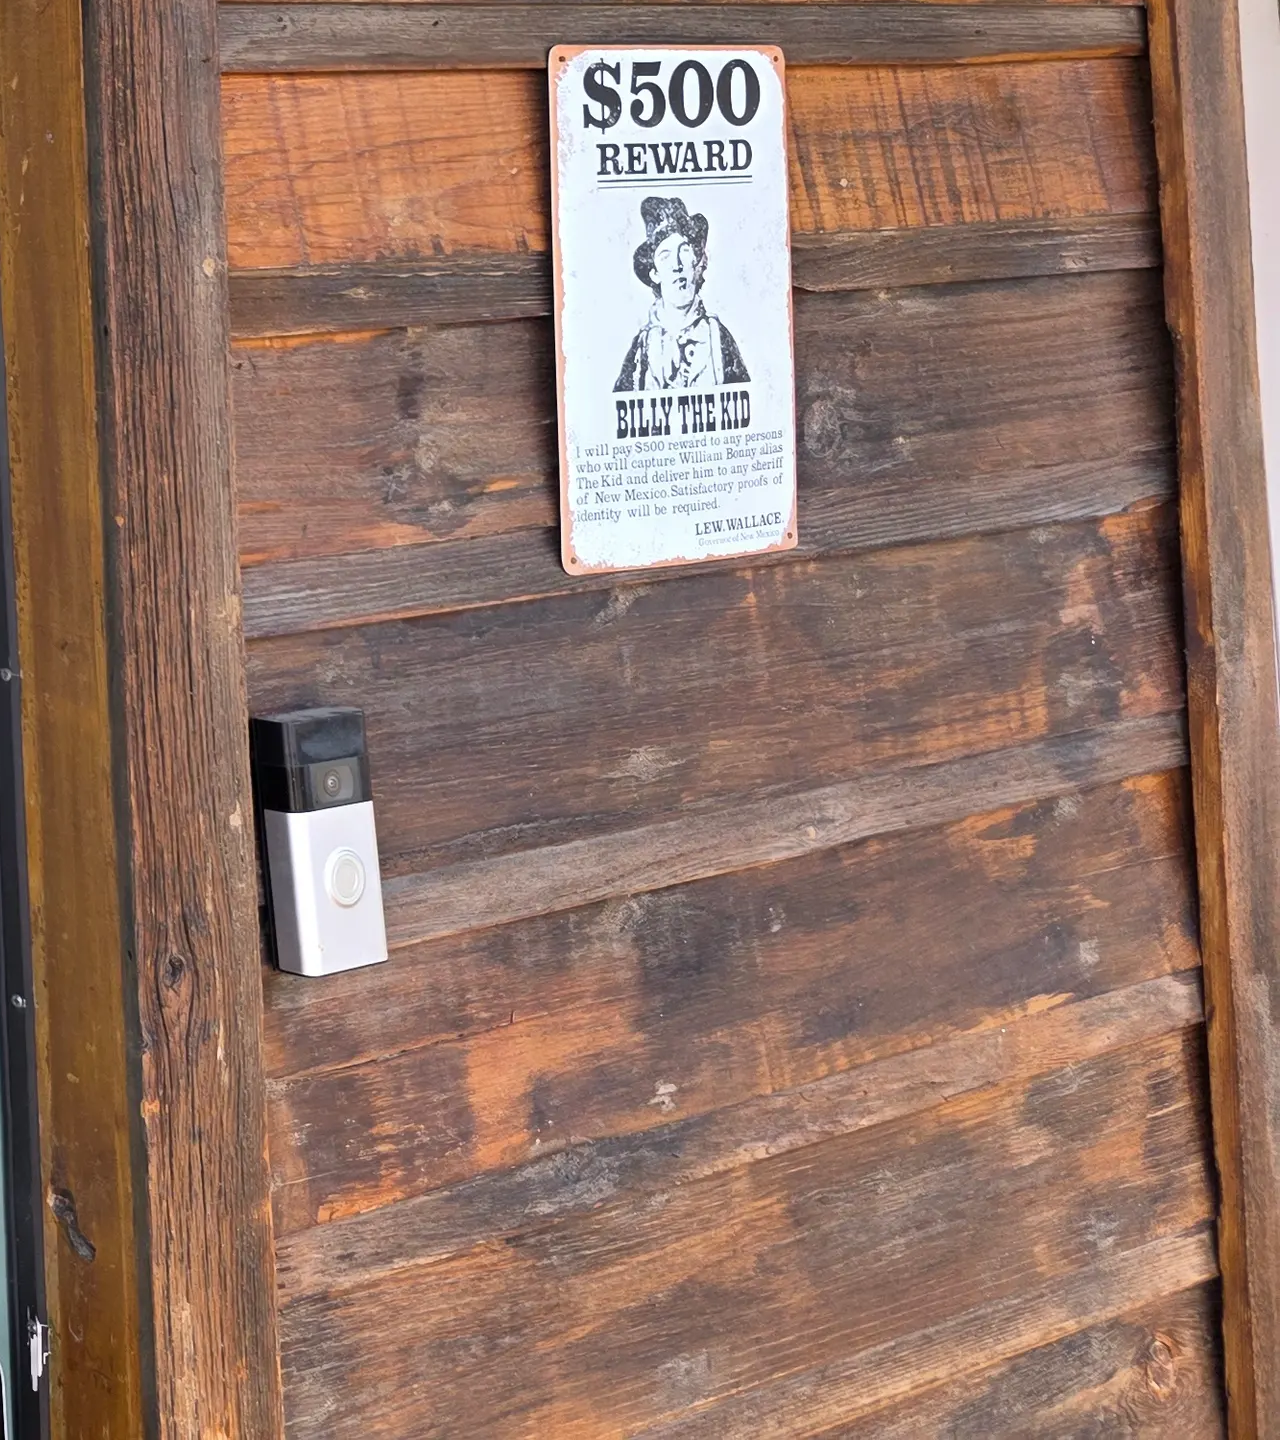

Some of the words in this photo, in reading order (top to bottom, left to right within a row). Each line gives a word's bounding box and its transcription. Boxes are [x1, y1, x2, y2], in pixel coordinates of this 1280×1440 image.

[582, 58, 761, 134] $500
[596, 139, 753, 176] REWARD
[616, 396, 673, 439] BILLY
[678, 394, 716, 435] THE
[720, 390, 751, 431] KID
[576, 446, 580, 458] I
[585, 443, 609, 457] will
[612, 445, 632, 459] pay
[634, 440, 665, 453] $500
[668, 435, 707, 451] reward
[710, 436, 720, 446] to
[723, 434, 742, 447] any
[745, 429, 783, 446] persons
[576, 461, 601, 473] who
[604, 457, 628, 471] will
[631, 456, 676, 471] capture
[679, 451, 723, 464] William
[726, 447, 756, 460] Bonny
[759, 443, 783, 456] alias
[576, 476, 599, 490] The
[601, 474, 623, 488] Kid
[626, 472, 648, 485] and
[652, 469, 690, 483] deliver
[692, 467, 714, 479] him
[717, 466, 727, 476] to
[730, 464, 748, 476] any
[751, 456, 784, 472] sheriff
[576, 492, 589, 505] of
[595, 491, 621, 504] New
[670, 481, 734, 497] Satisfactory
[738, 474, 768, 493] proofs
[772, 472, 783, 485] of
[577, 508, 621, 523] identity
[627, 504, 650, 518] will
[654, 503, 667, 516] be
[672, 497, 721, 516] required.
